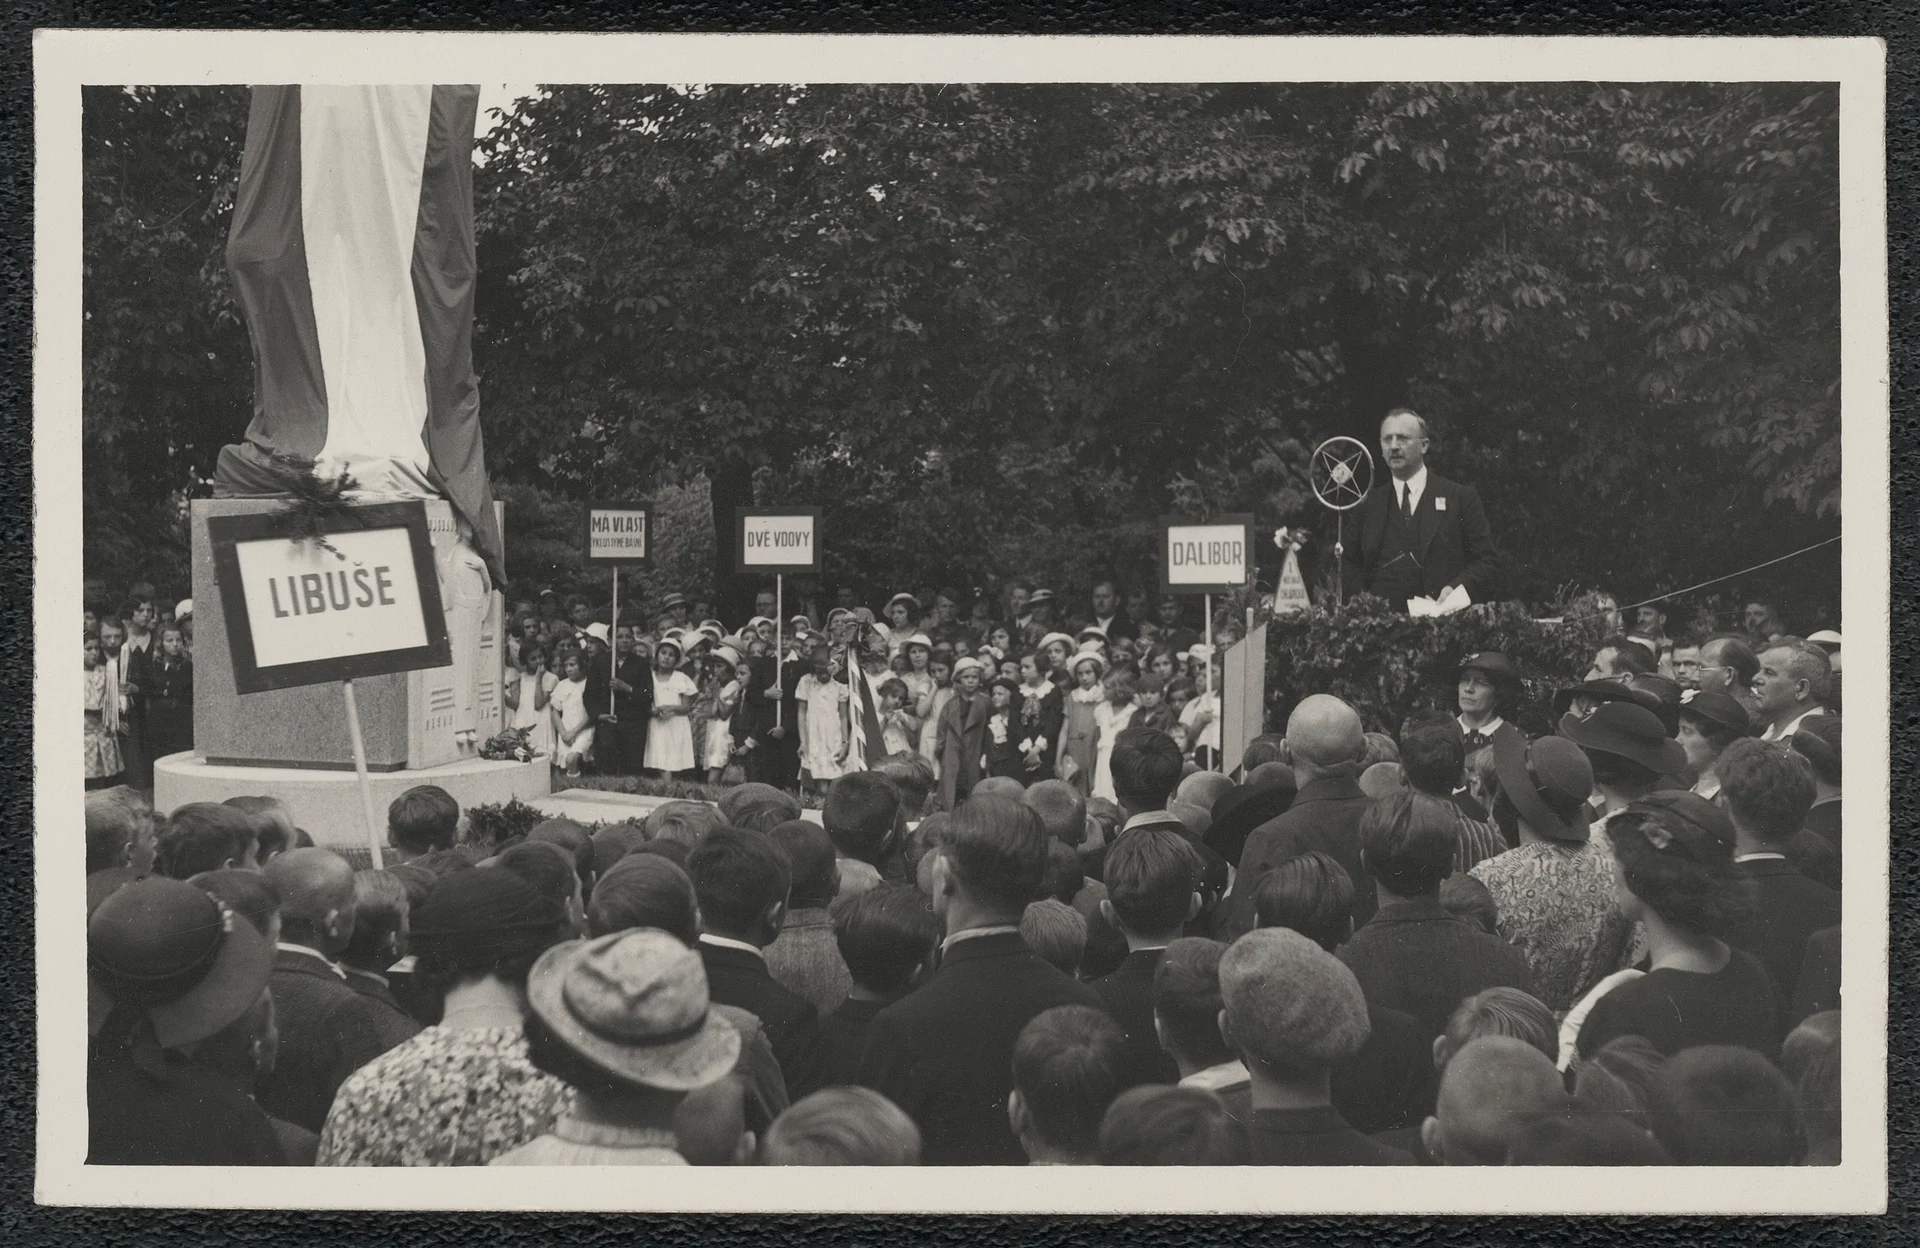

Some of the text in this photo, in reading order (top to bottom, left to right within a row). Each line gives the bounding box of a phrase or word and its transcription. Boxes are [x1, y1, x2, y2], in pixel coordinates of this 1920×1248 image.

[592, 512, 644, 533] MÁ VLAST
[773, 531, 810, 548] VDOVY
[1172, 540, 1242, 566] DALIBOR
[268, 561, 396, 619] LIBUŠE
